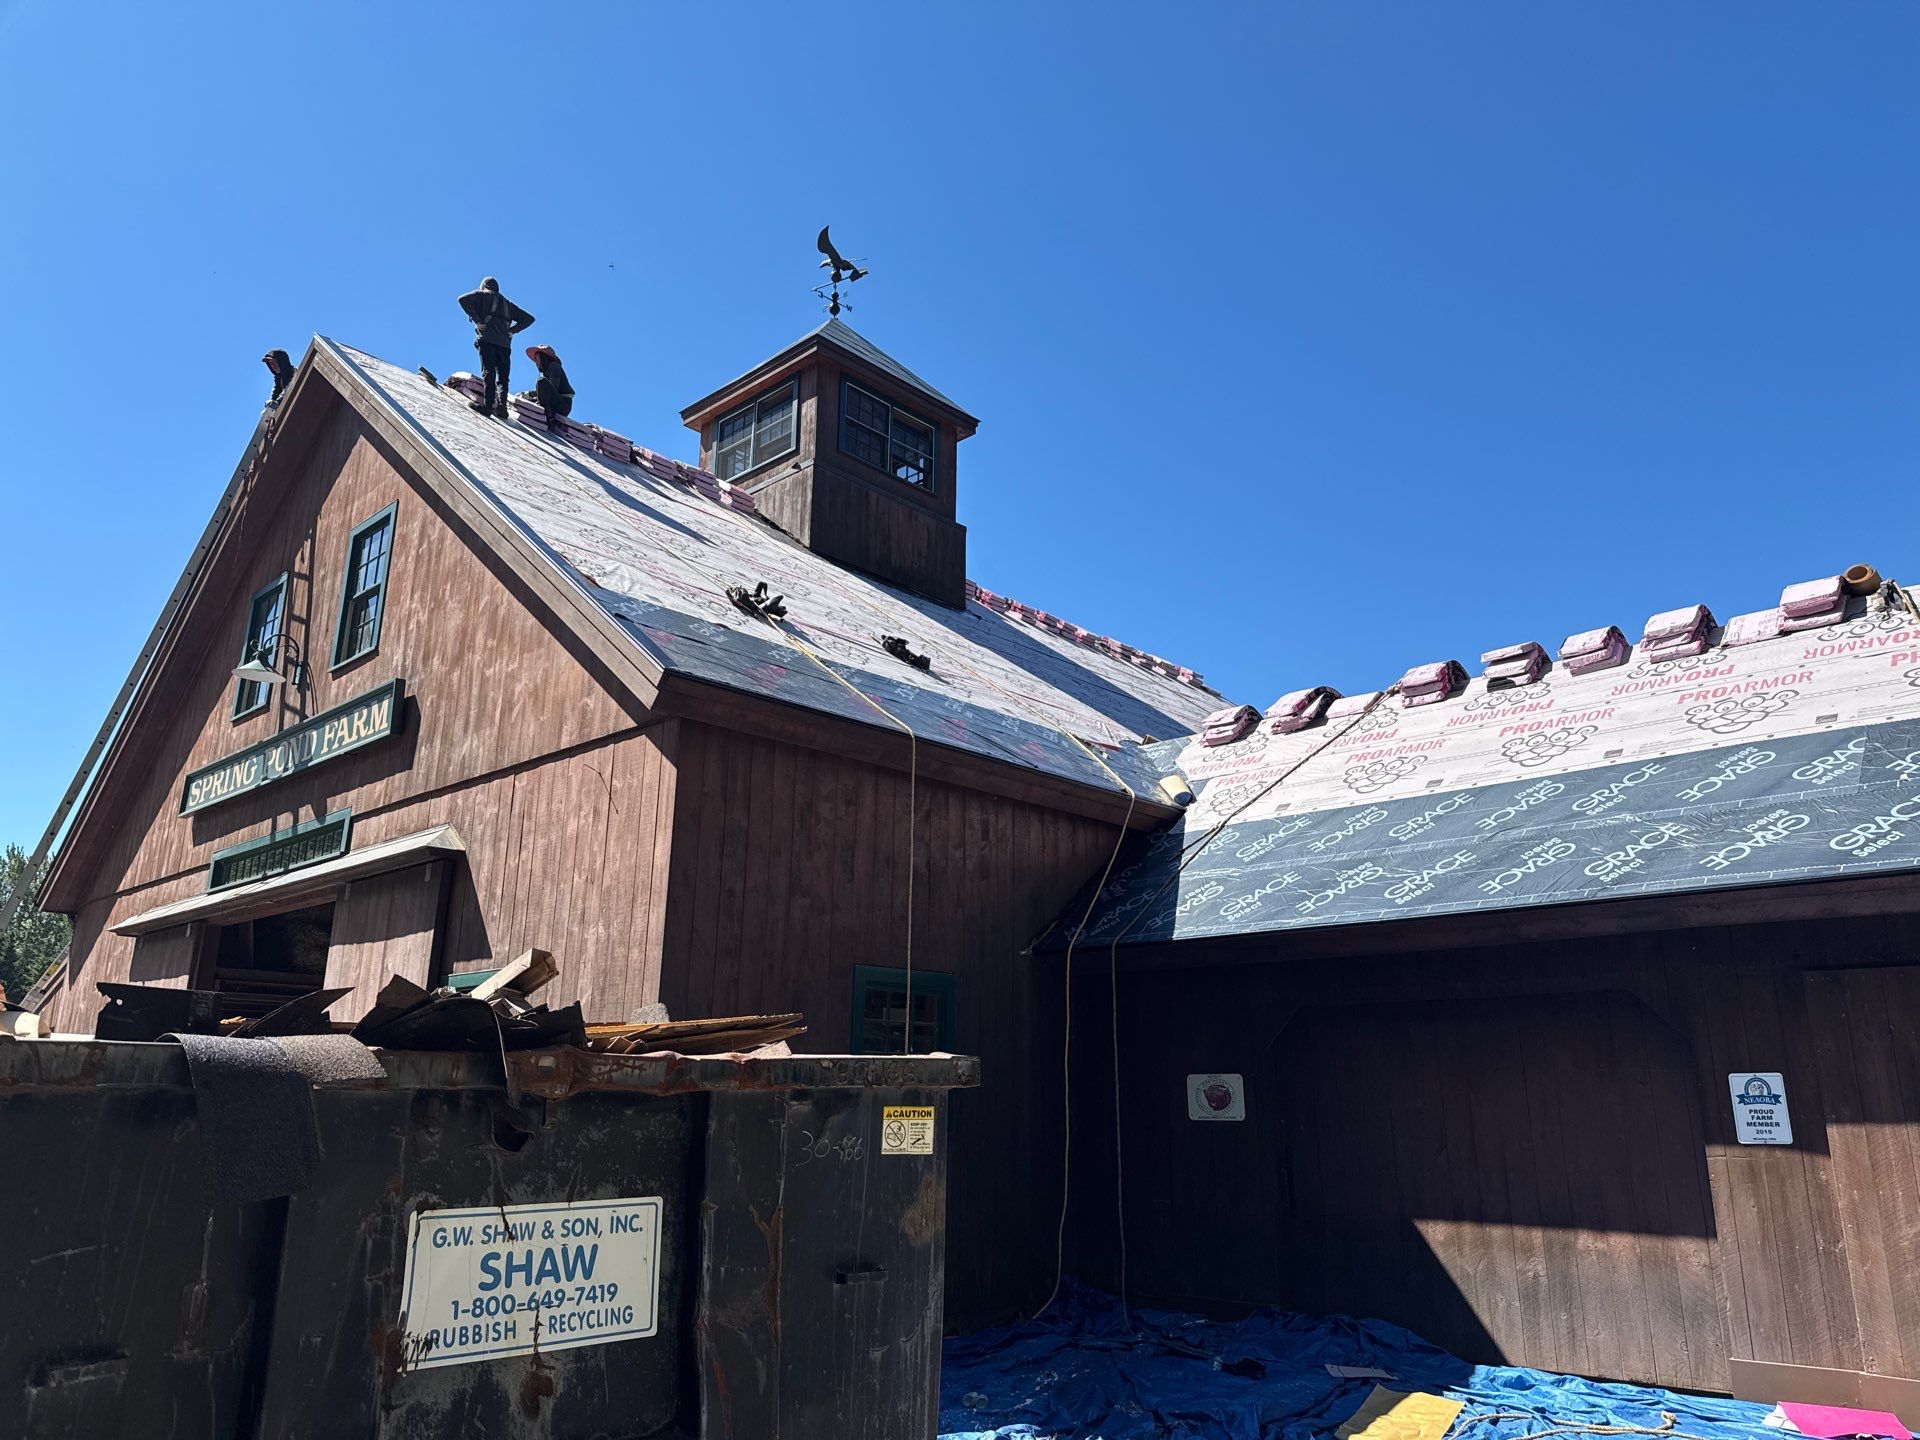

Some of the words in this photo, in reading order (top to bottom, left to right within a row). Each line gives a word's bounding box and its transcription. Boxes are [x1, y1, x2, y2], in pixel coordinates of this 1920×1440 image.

[1612, 664, 1734, 697] PROARMOR
[1678, 671, 1814, 704] PROARMOR
[1447, 699, 1554, 727] PROARMOR
[1499, 707, 1616, 736] PROARMOR
[188, 756, 257, 807] SPRING
[261, 731, 317, 780] POND
[321, 698, 390, 754] FARM
[1345, 738, 1446, 765] PROARMOR
[1715, 746, 1759, 768] Select
[1514, 779, 1552, 799] Select
[1572, 763, 1666, 811] GRACE
[1676, 751, 1776, 802] GRACE
[1811, 761, 1859, 785] Select
[1345, 805, 1378, 824] Select
[1389, 793, 1474, 837] GRACE
[1475, 783, 1565, 830] GRACE
[1586, 794, 1627, 816] Select
[1743, 808, 1790, 832] Select
[1236, 816, 1312, 858] GRACE
[1307, 810, 1388, 853] GRACE
[1399, 822, 1436, 841] Select
[1698, 814, 1811, 871] GRACE
[1852, 830, 1906, 858] Select
[1243, 844, 1275, 862] Select
[1520, 837, 1562, 860] Select
[1584, 822, 1690, 877] GRACE
[1336, 861, 1374, 882] Select
[1384, 850, 1477, 899] GRACE
[1478, 843, 1576, 895] GRACE
[1599, 858, 1645, 883] Select
[1220, 871, 1301, 915] GRACE
[1295, 867, 1384, 914] GRACE
[1395, 882, 1435, 905] Select
[1227, 901, 1262, 922] Select
[893, 1109, 932, 1118] CAUTION
[432, 1226, 474, 1249] G.W.
[481, 1221, 536, 1245] SHAW
[541, 1219, 554, 1240] &
[560, 1216, 603, 1240] SON,
[609, 1213, 643, 1234] INC.
[478, 1243, 598, 1292] SHAW
[451, 1282, 618, 1321] 1-800-649-7419
[430, 1319, 517, 1350] RUBBISH
[548, 1305, 634, 1335] RECYCLING
